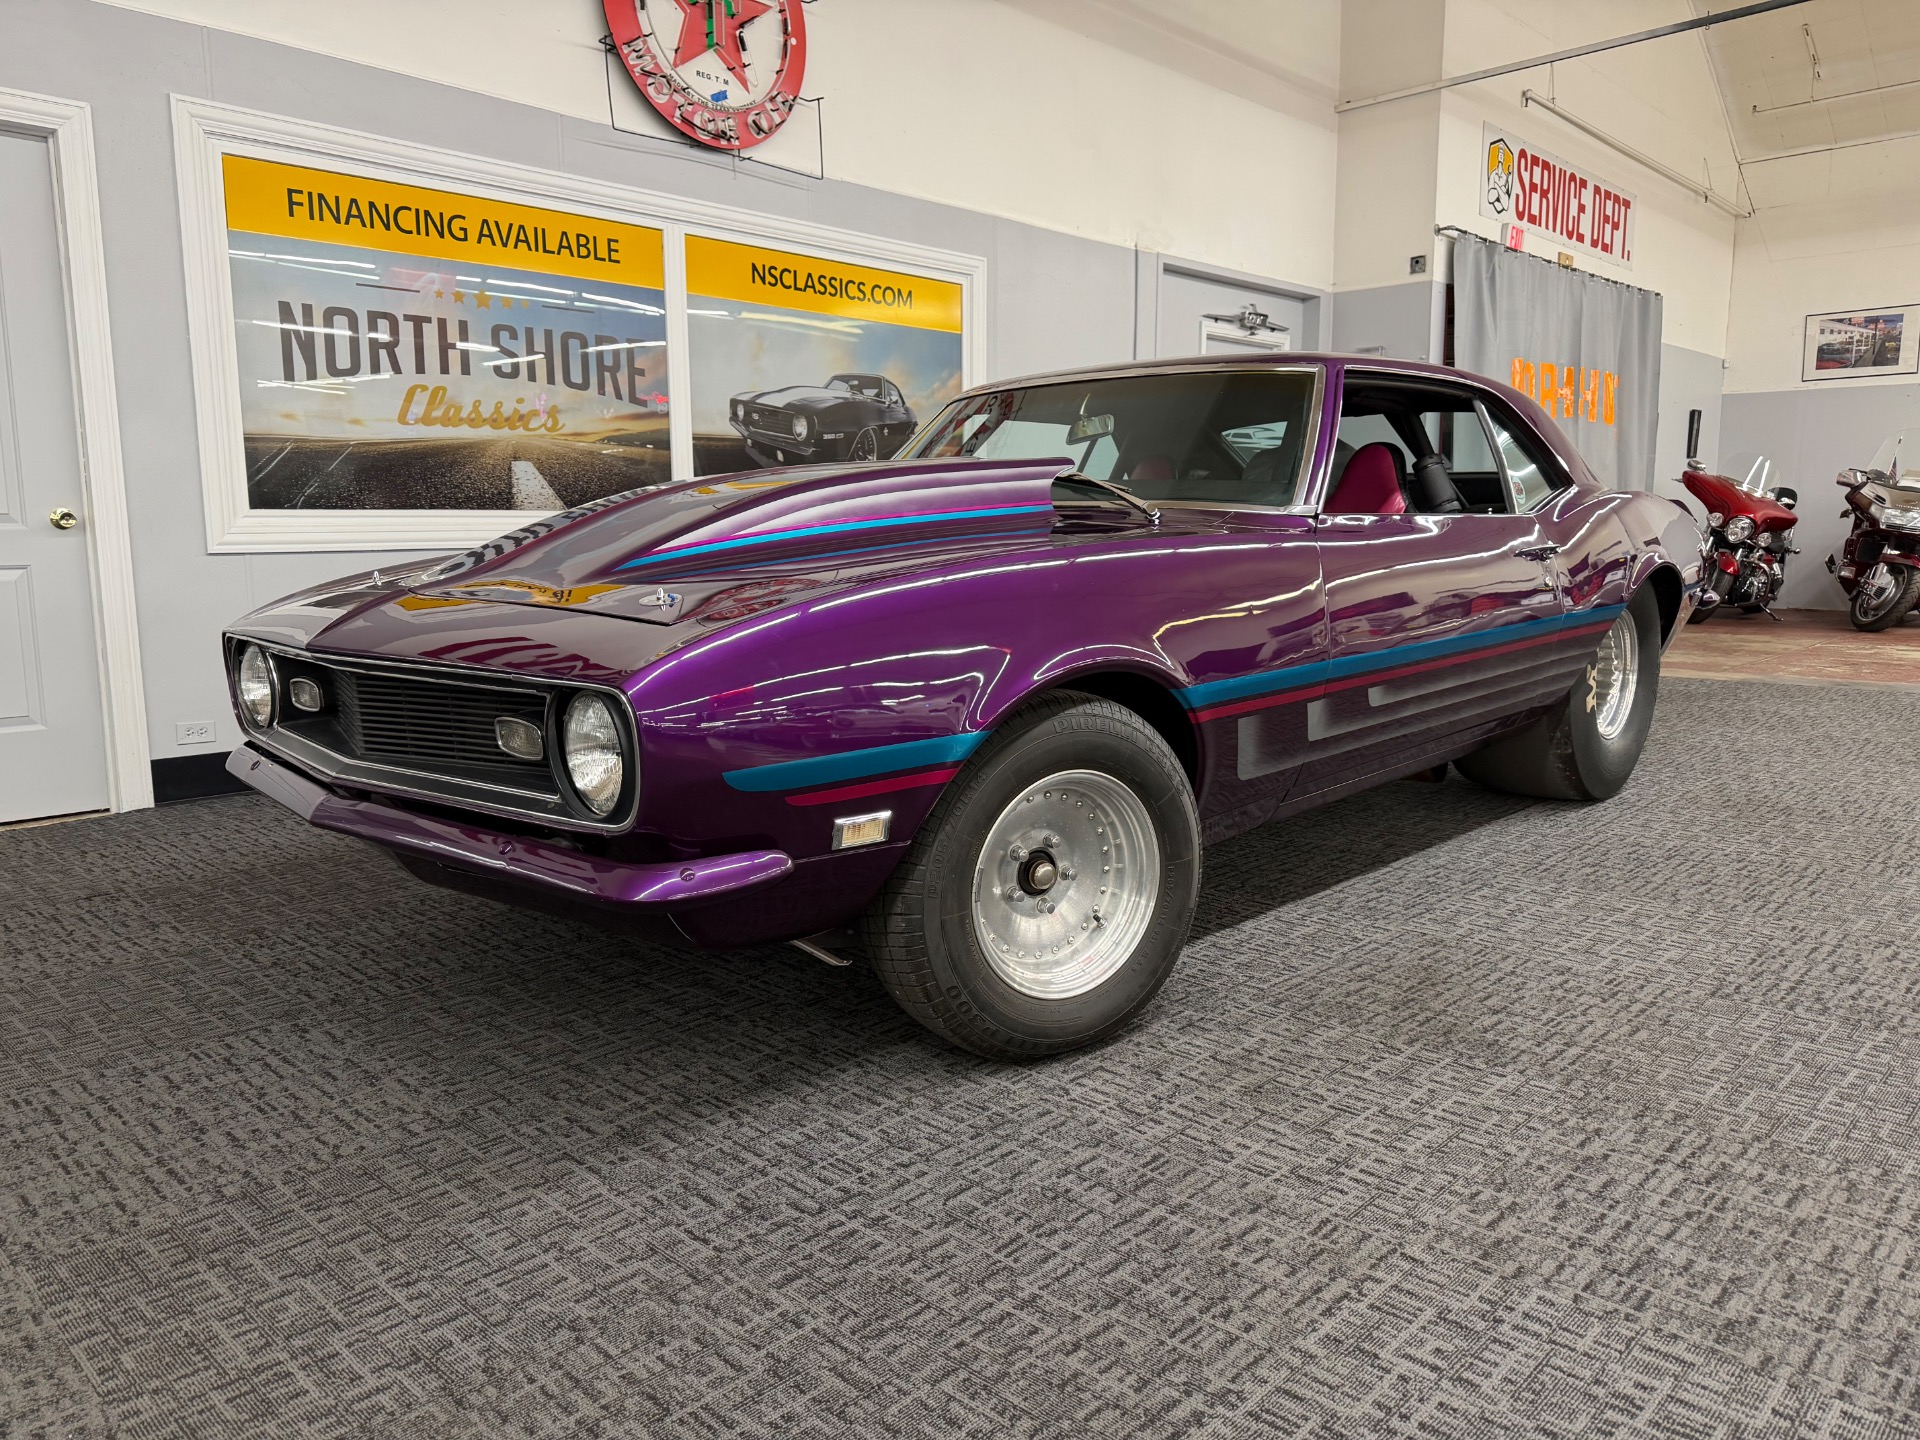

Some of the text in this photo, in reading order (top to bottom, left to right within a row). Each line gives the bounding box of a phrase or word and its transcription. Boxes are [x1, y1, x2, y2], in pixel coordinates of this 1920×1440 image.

[286, 187, 622, 265] FINANCING AVAILABLE
[1514, 148, 1632, 262] SERVICE DEPT.
[751, 262, 914, 310] NSCLASSICS.COM
[277, 300, 648, 408] NORTH SHORE
[396, 383, 567, 434] Classics
[1052, 716, 1138, 743] PIRELLI
[927, 771, 988, 899] P205/70R14
